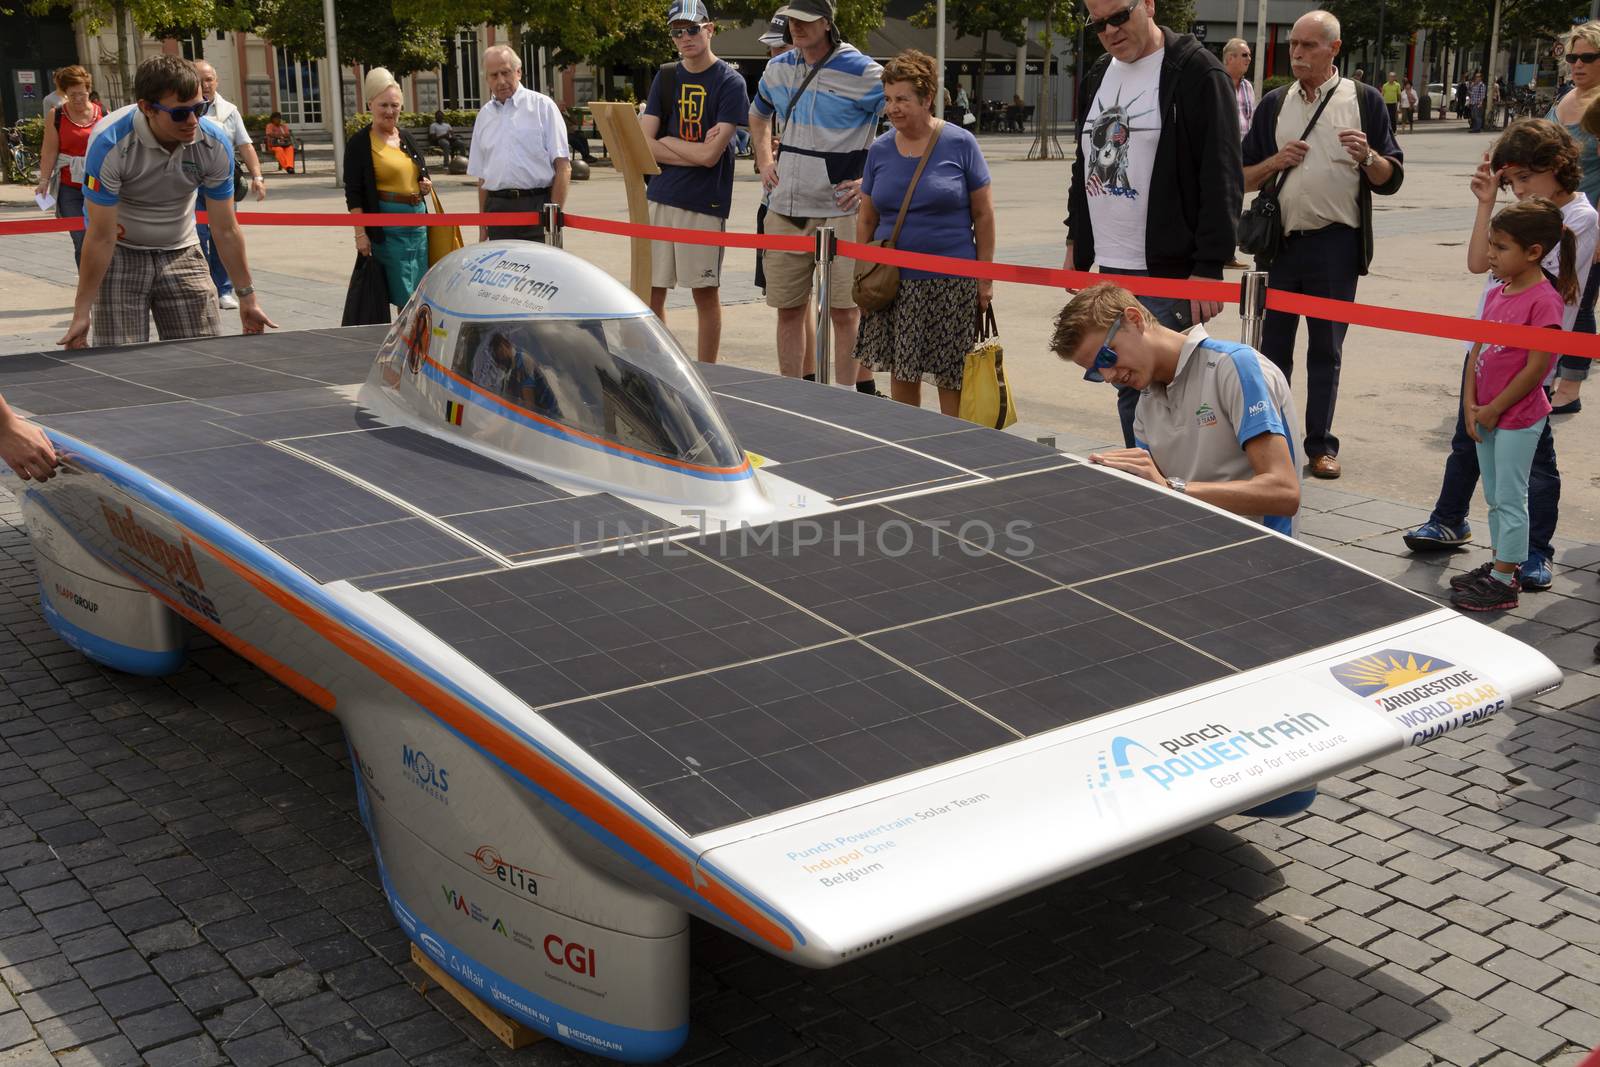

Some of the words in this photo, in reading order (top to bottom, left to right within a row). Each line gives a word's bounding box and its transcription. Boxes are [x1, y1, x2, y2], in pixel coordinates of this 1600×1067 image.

[495, 260, 531, 273] punch
[73, 595, 99, 613] GROUP
[1375, 670, 1479, 713] BRIDGESTONE
[1159, 722, 1232, 755] punch
[403, 744, 449, 792] MOLS
[1209, 771, 1242, 789] Gear
[1246, 763, 1265, 778] up
[1263, 756, 1284, 769] for
[1285, 746, 1310, 762] the
[1308, 734, 1349, 753] future
[786, 839, 836, 861] Punch
[834, 815, 917, 847] Powertrain
[914, 804, 953, 821] Solar
[951, 791, 991, 810] Team
[802, 849, 864, 874] Indupol
[863, 839, 897, 855] One
[496, 864, 538, 896] elia
[819, 861, 885, 888] Belgium
[543, 933, 596, 978] CGI
[461, 964, 484, 989] Altair
[568, 1027, 623, 1052] HEIDENHAIN
